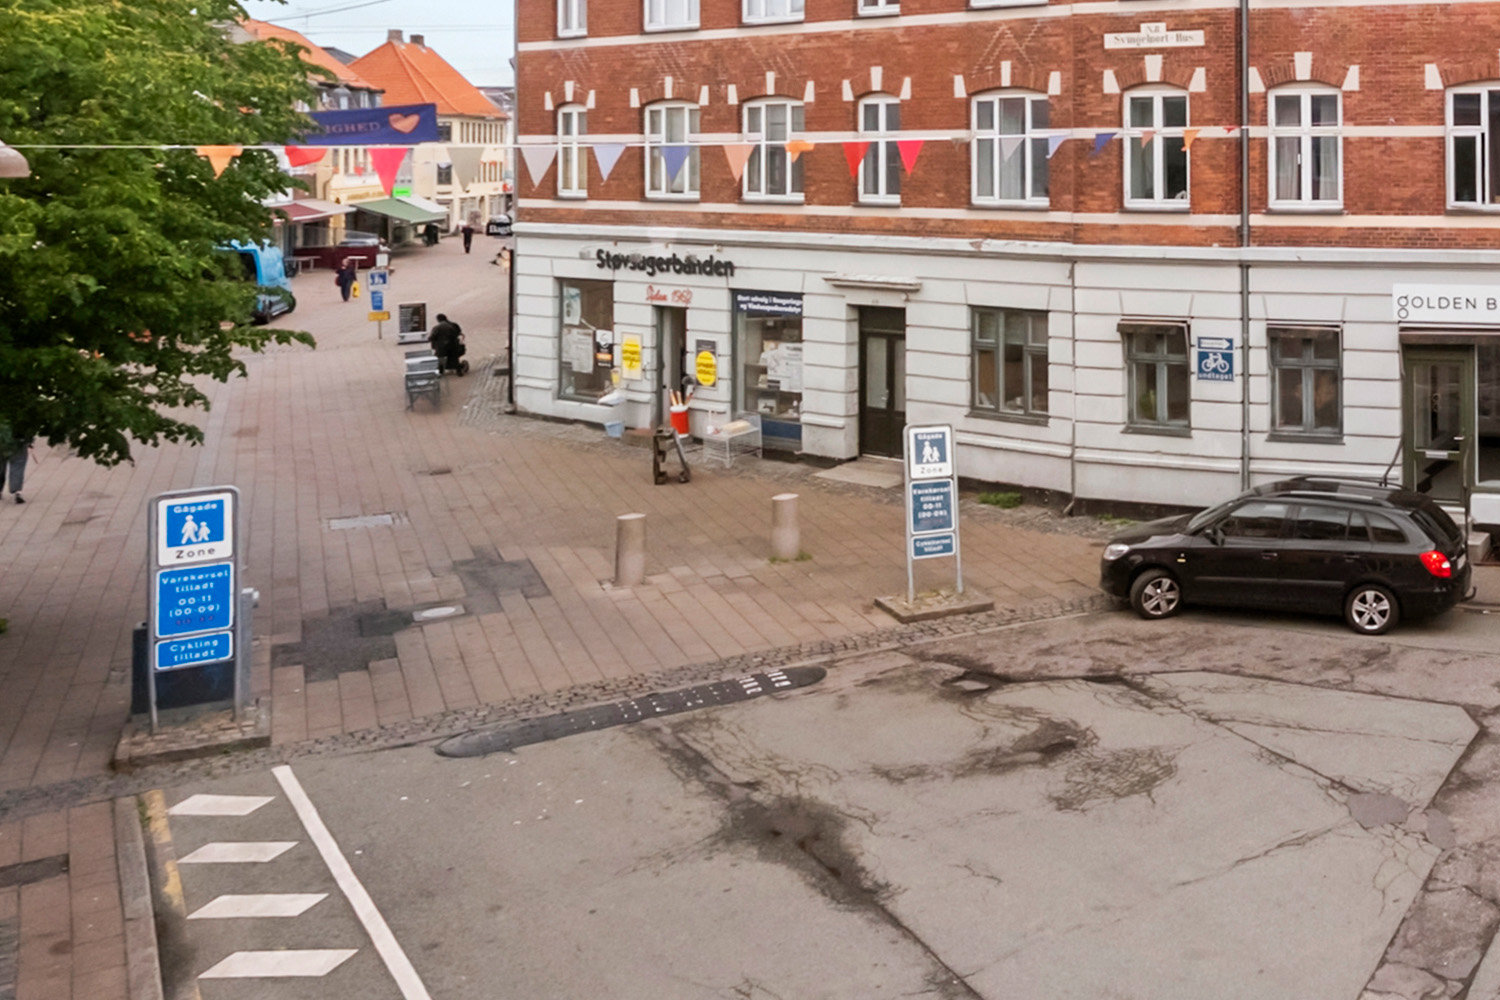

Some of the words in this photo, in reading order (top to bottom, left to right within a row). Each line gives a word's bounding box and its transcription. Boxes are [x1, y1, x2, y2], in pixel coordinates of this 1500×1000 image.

[596, 248, 735, 277] Støvsugerbanden
[174, 502, 217, 513] Gågade
[176, 548, 216, 558] Zone
[162, 570, 228, 584] Varekørsel
[176, 582, 213, 592] tilladt
[170, 640, 218, 652] Cykling
[174, 650, 214, 662] tilladt
